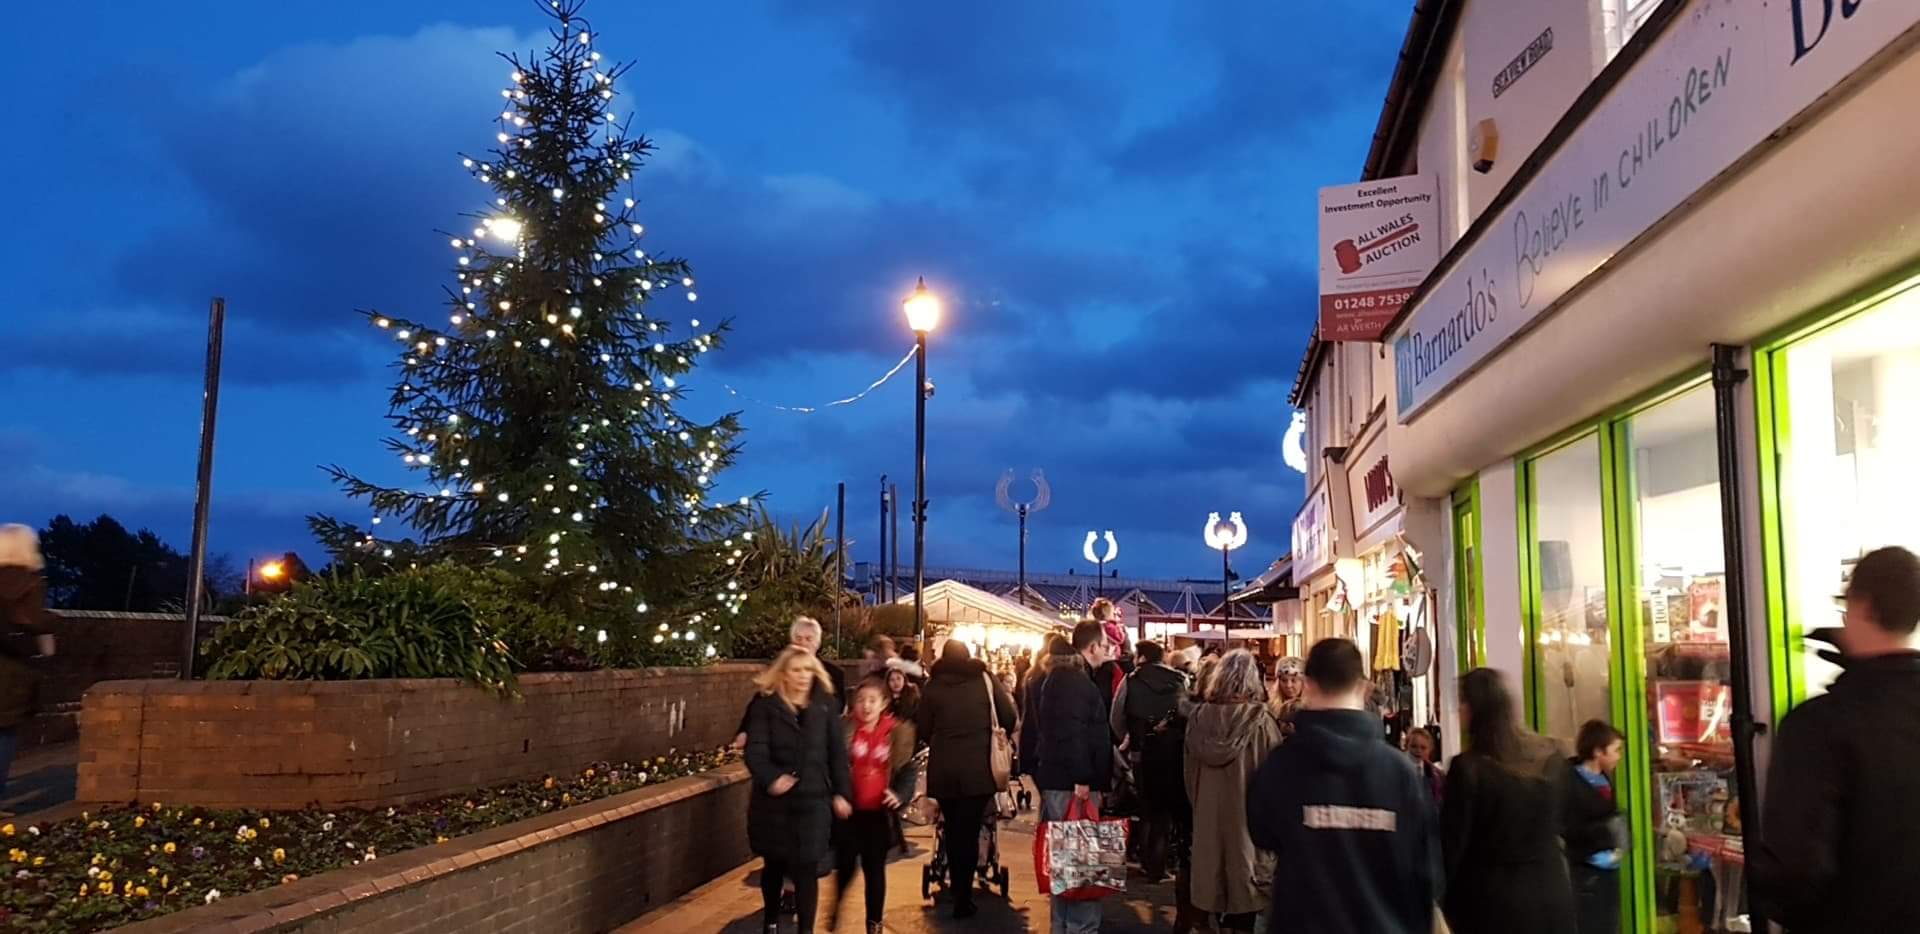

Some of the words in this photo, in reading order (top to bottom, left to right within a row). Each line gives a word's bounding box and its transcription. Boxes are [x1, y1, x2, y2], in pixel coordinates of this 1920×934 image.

[1528, 29, 1552, 65] ROAD
[1325, 200, 1374, 213] Investment
[1376, 193, 1432, 208] Opportunity
[1357, 186, 1398, 198] Excellent
[1358, 230, 1377, 246] ALL
[1377, 213, 1414, 235] WALES
[1413, 268, 1498, 386] Barnardo's
[1618, 48, 1731, 188] CHILDREN
[1366, 232, 1421, 264] AUCTION
[1334, 296, 1375, 310] 01248
